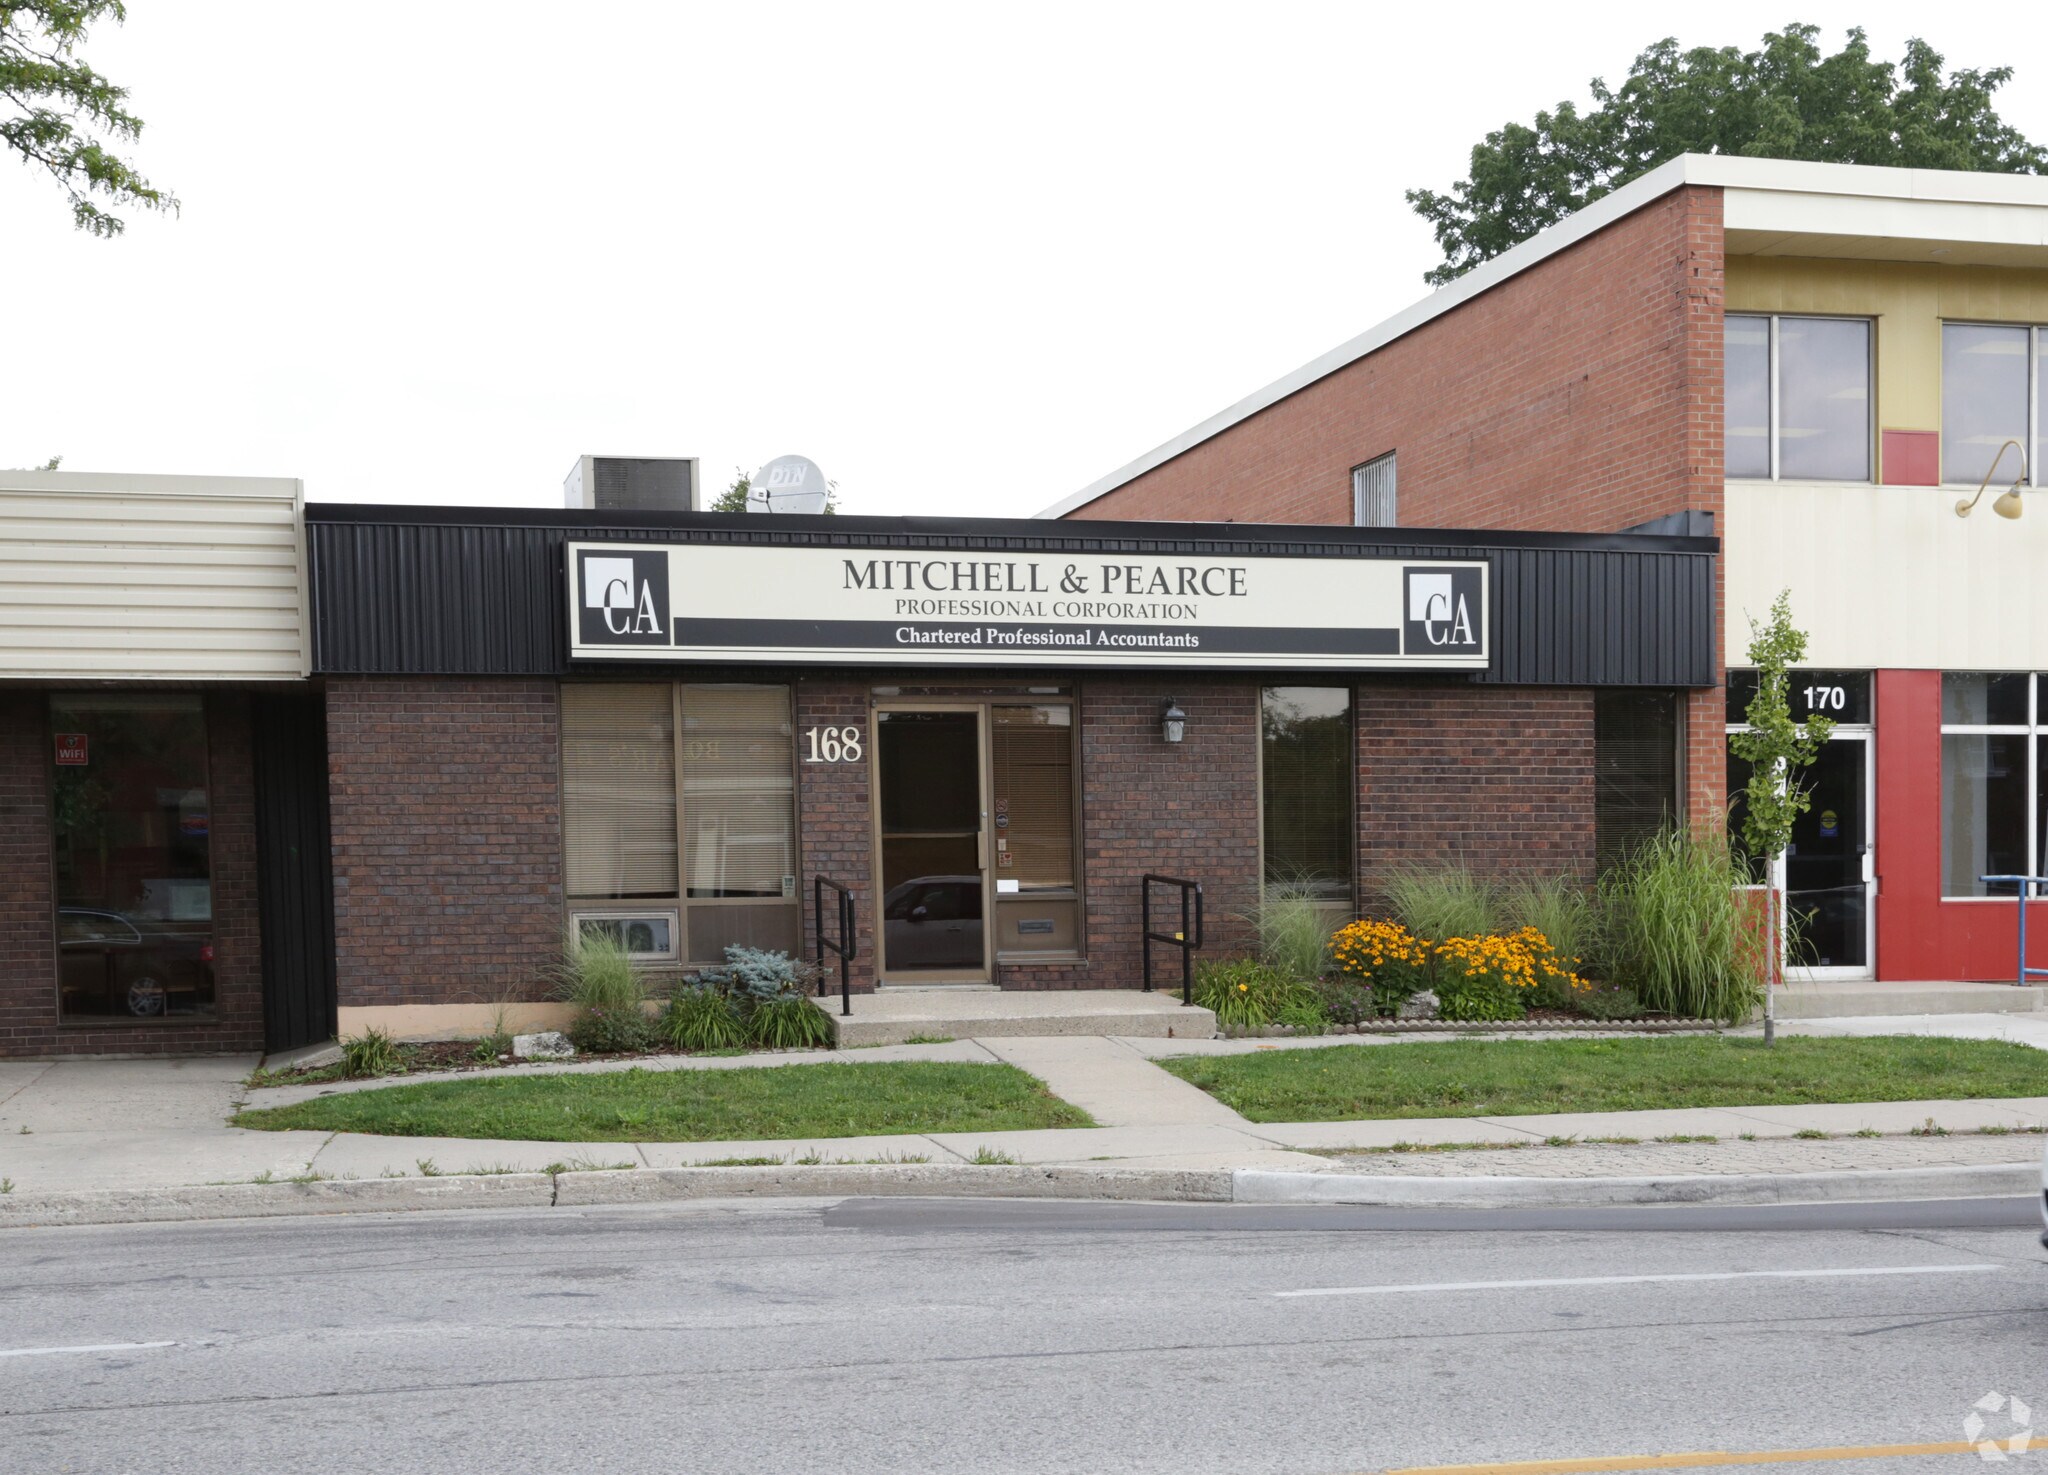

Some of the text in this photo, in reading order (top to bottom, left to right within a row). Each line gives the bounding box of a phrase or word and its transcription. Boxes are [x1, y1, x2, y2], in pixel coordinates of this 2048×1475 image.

[842, 558, 1248, 597] MITCHELL & PEARCE
[602, 578, 664, 636] CA
[895, 598, 1198, 620] PROFESSIONAL CORPORATION
[1423, 591, 1478, 646] CA
[895, 626, 1200, 648] Chartered Professional Accountants
[1803, 686, 1846, 710] 170
[805, 726, 862, 763] 168
